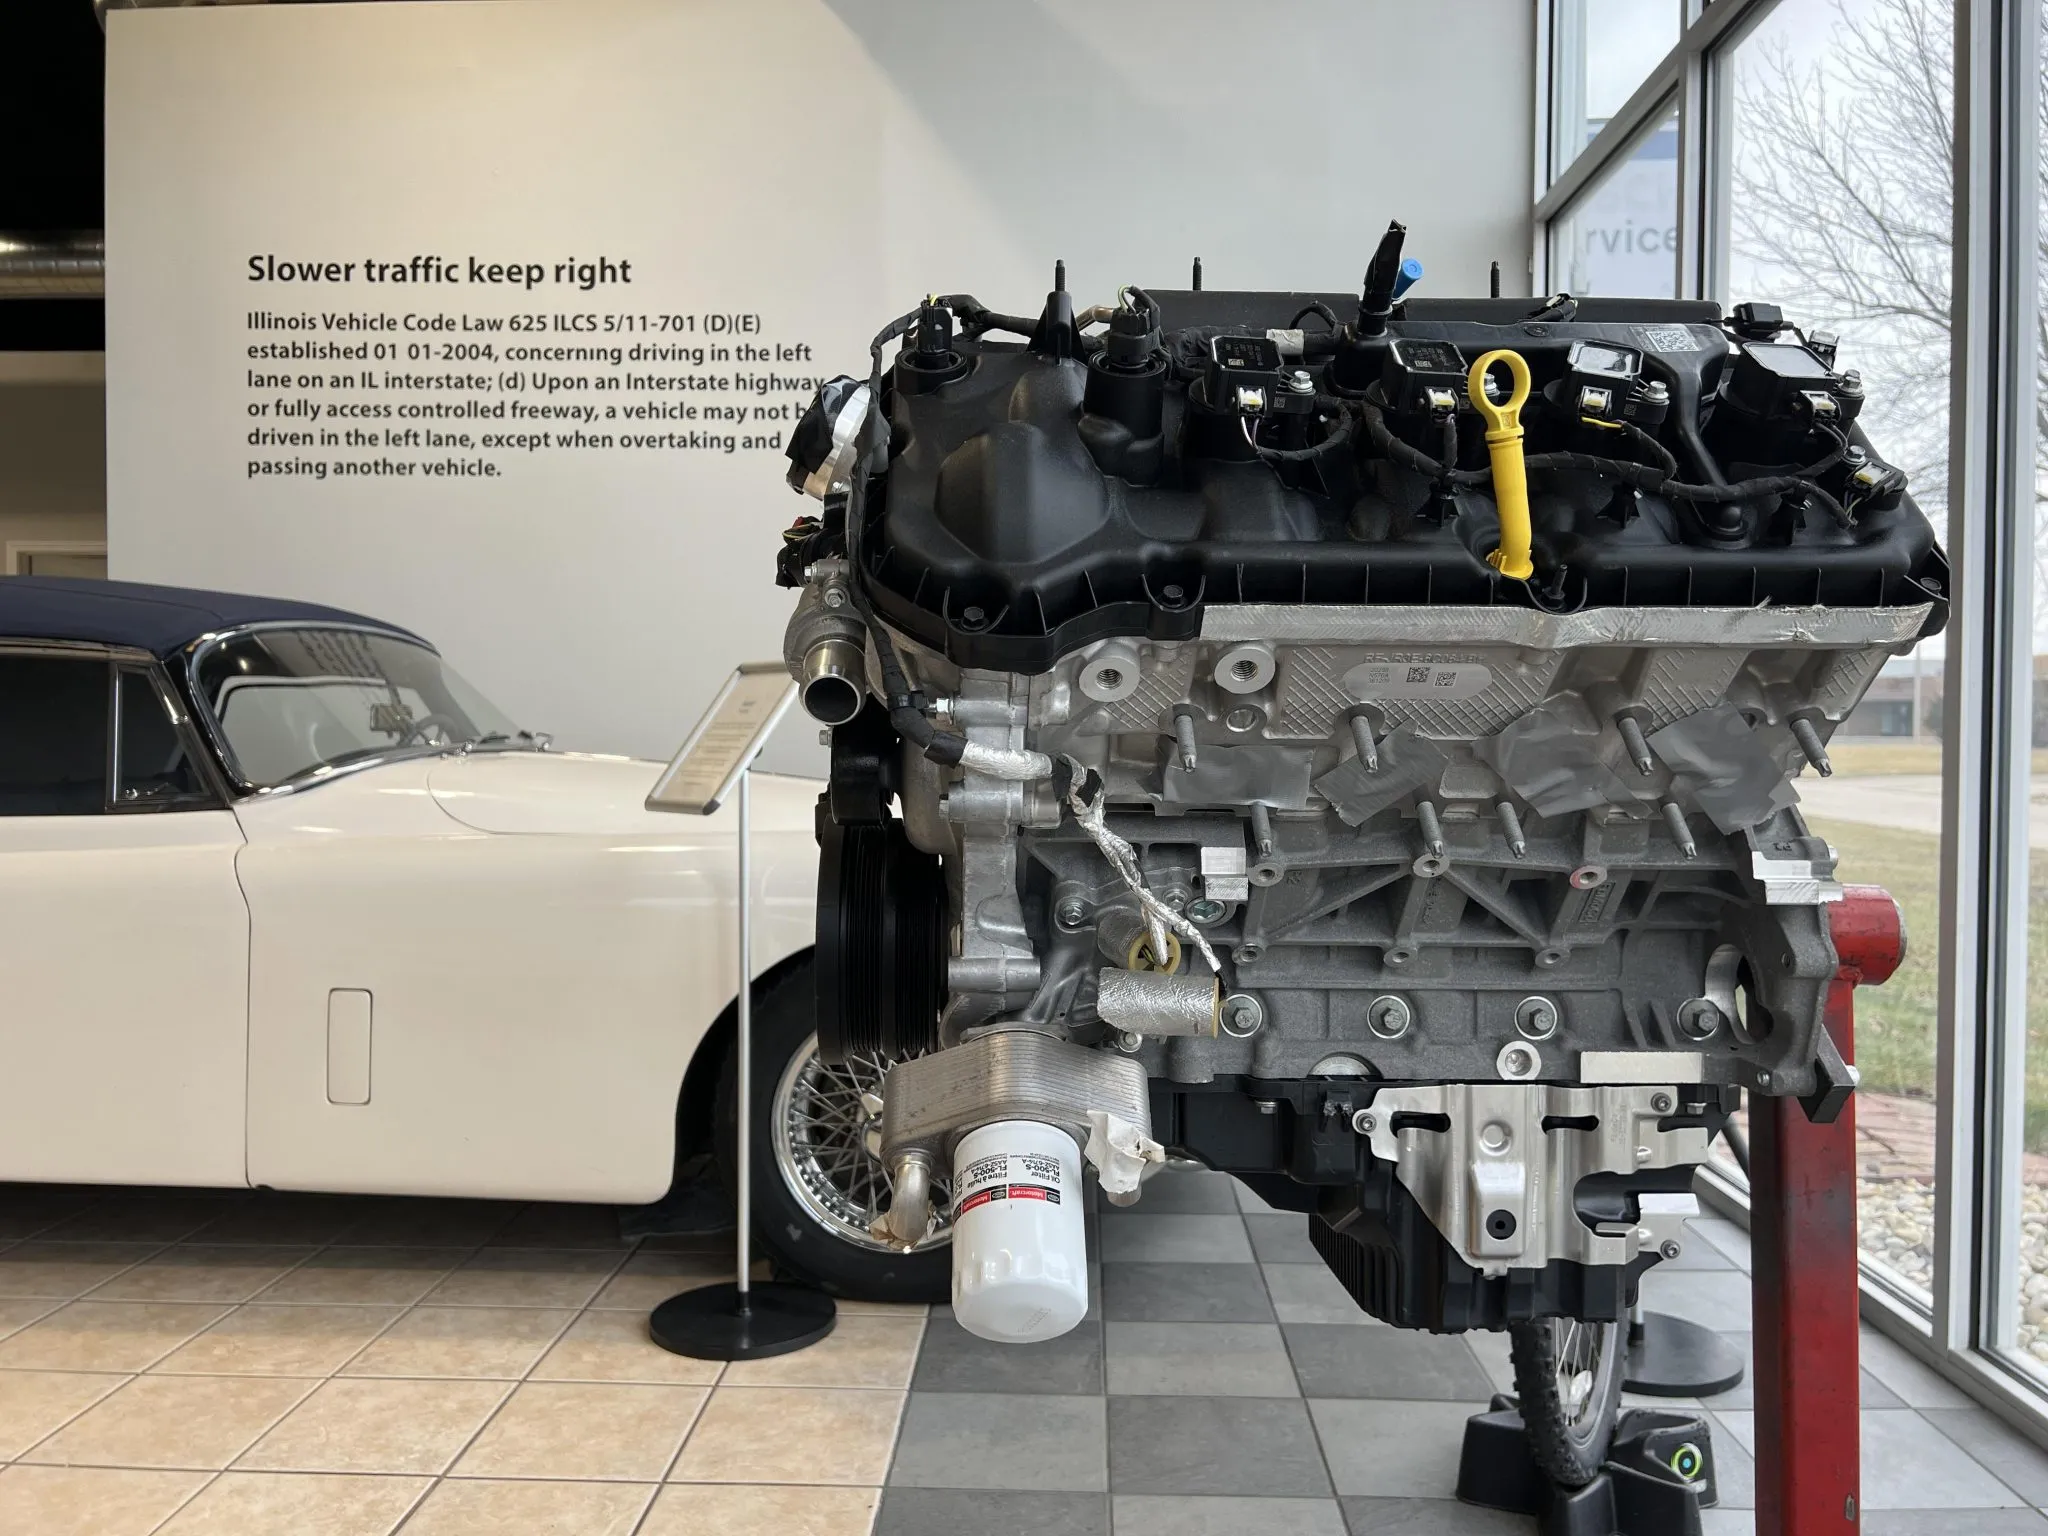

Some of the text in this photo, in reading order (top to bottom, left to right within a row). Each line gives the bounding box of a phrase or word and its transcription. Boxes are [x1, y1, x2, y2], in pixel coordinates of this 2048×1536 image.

[1585, 218, 1676, 255] rvice
[247, 253, 632, 292] Slower traffic keep right
[247, 310, 761, 336] Illinois Vehicle Code Law 625 ILCS 5/11-701 (D)(E)
[247, 340, 368, 361] established
[627, 342, 705, 367] driving
[710, 342, 730, 362] in
[734, 342, 771, 362] the
[775, 342, 813, 362] left
[247, 368, 825, 396] lane on an IL interstate; (d) Upon an Interstate highway
[247, 399, 808, 426] or fully access controlled freeway, a vehicle may not b
[247, 426, 782, 455] driven in the left lane, except when overtaking and
[247, 456, 502, 481] passing another vehicle.
[973, 1164, 1007, 1179] FL-500-S
[987, 1171, 1007, 1180] Filtre
[1025, 1163, 1060, 1177] FL-500-S
[1031, 1171, 1061, 1184] Oil Filter
[1011, 1190, 1044, 1198] Motorcraft
